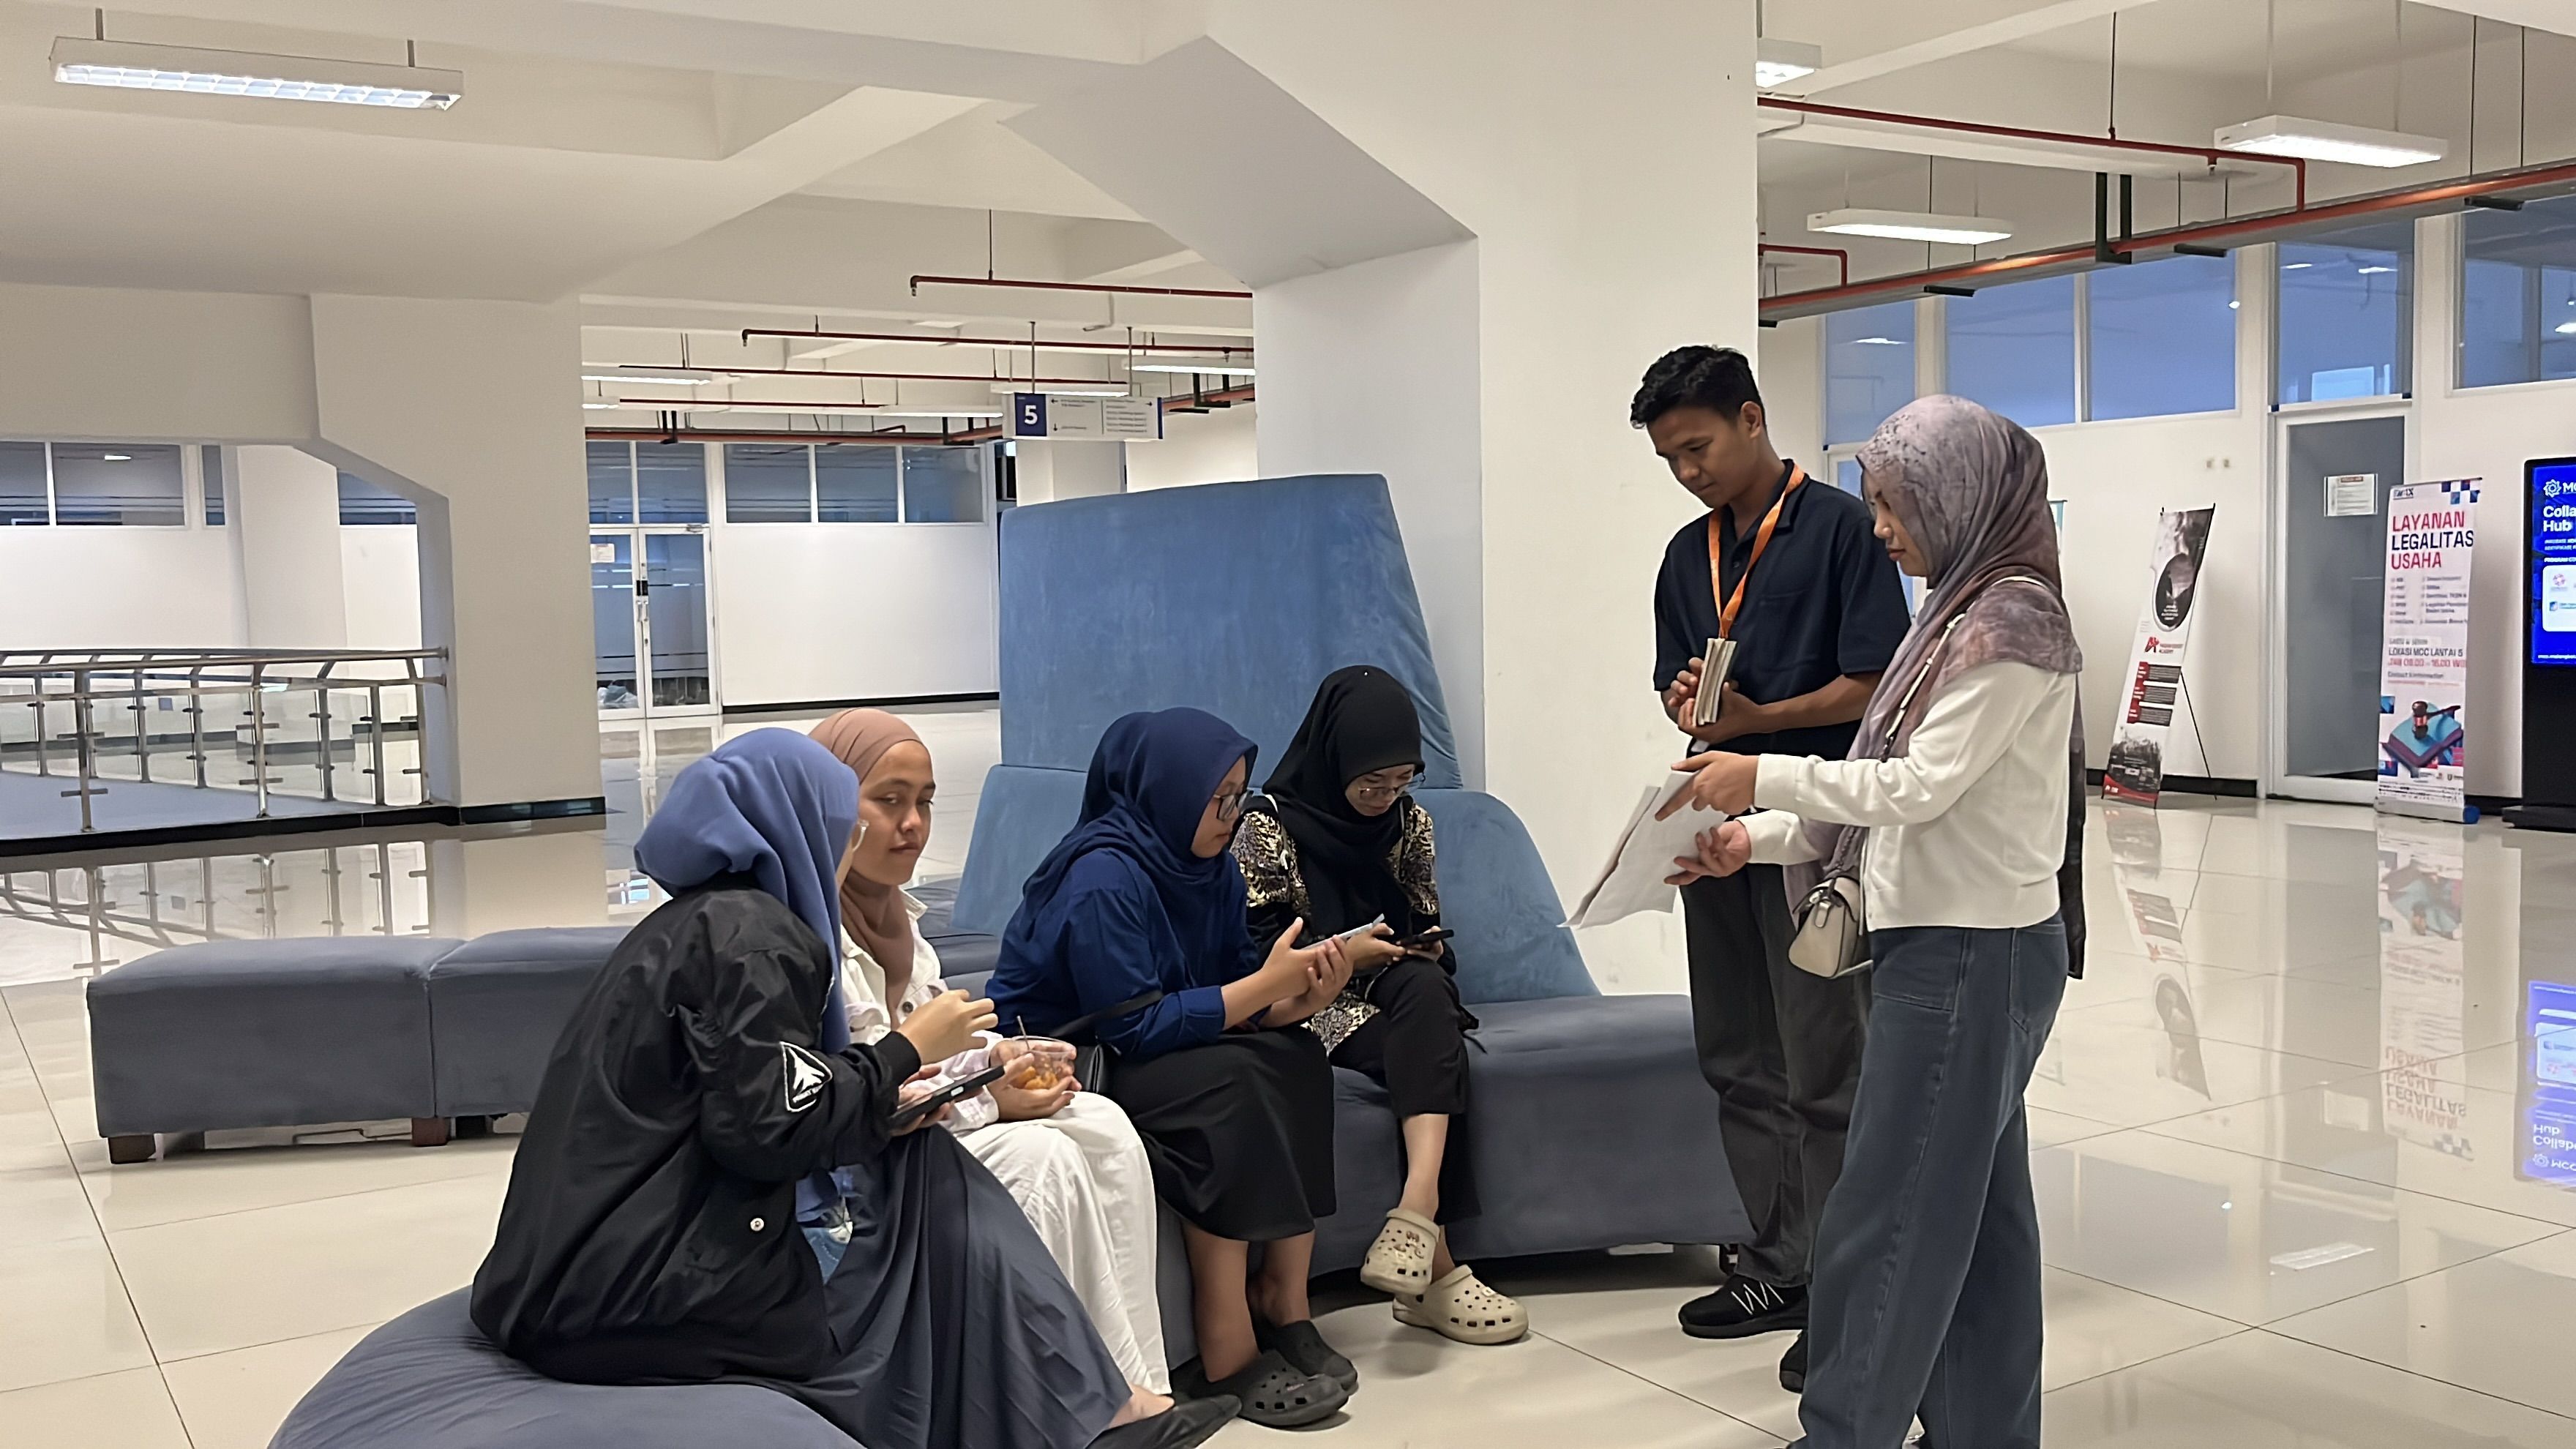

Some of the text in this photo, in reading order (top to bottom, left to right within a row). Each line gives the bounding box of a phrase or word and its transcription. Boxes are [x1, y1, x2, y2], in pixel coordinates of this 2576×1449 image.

[1024, 404, 1038, 425] 5
[2543, 505, 2576, 517] Colla
[2392, 511, 2465, 532] LAYANAN
[2543, 519, 2572, 532] Hub
[2392, 530, 2474, 550] LEGALITAS
[2391, 552, 2441, 570] USAHA
[2389, 647, 2412, 656] LOKASI
[2413, 648, 2429, 656] MCC
[2430, 648, 2456, 657] LANTAI
